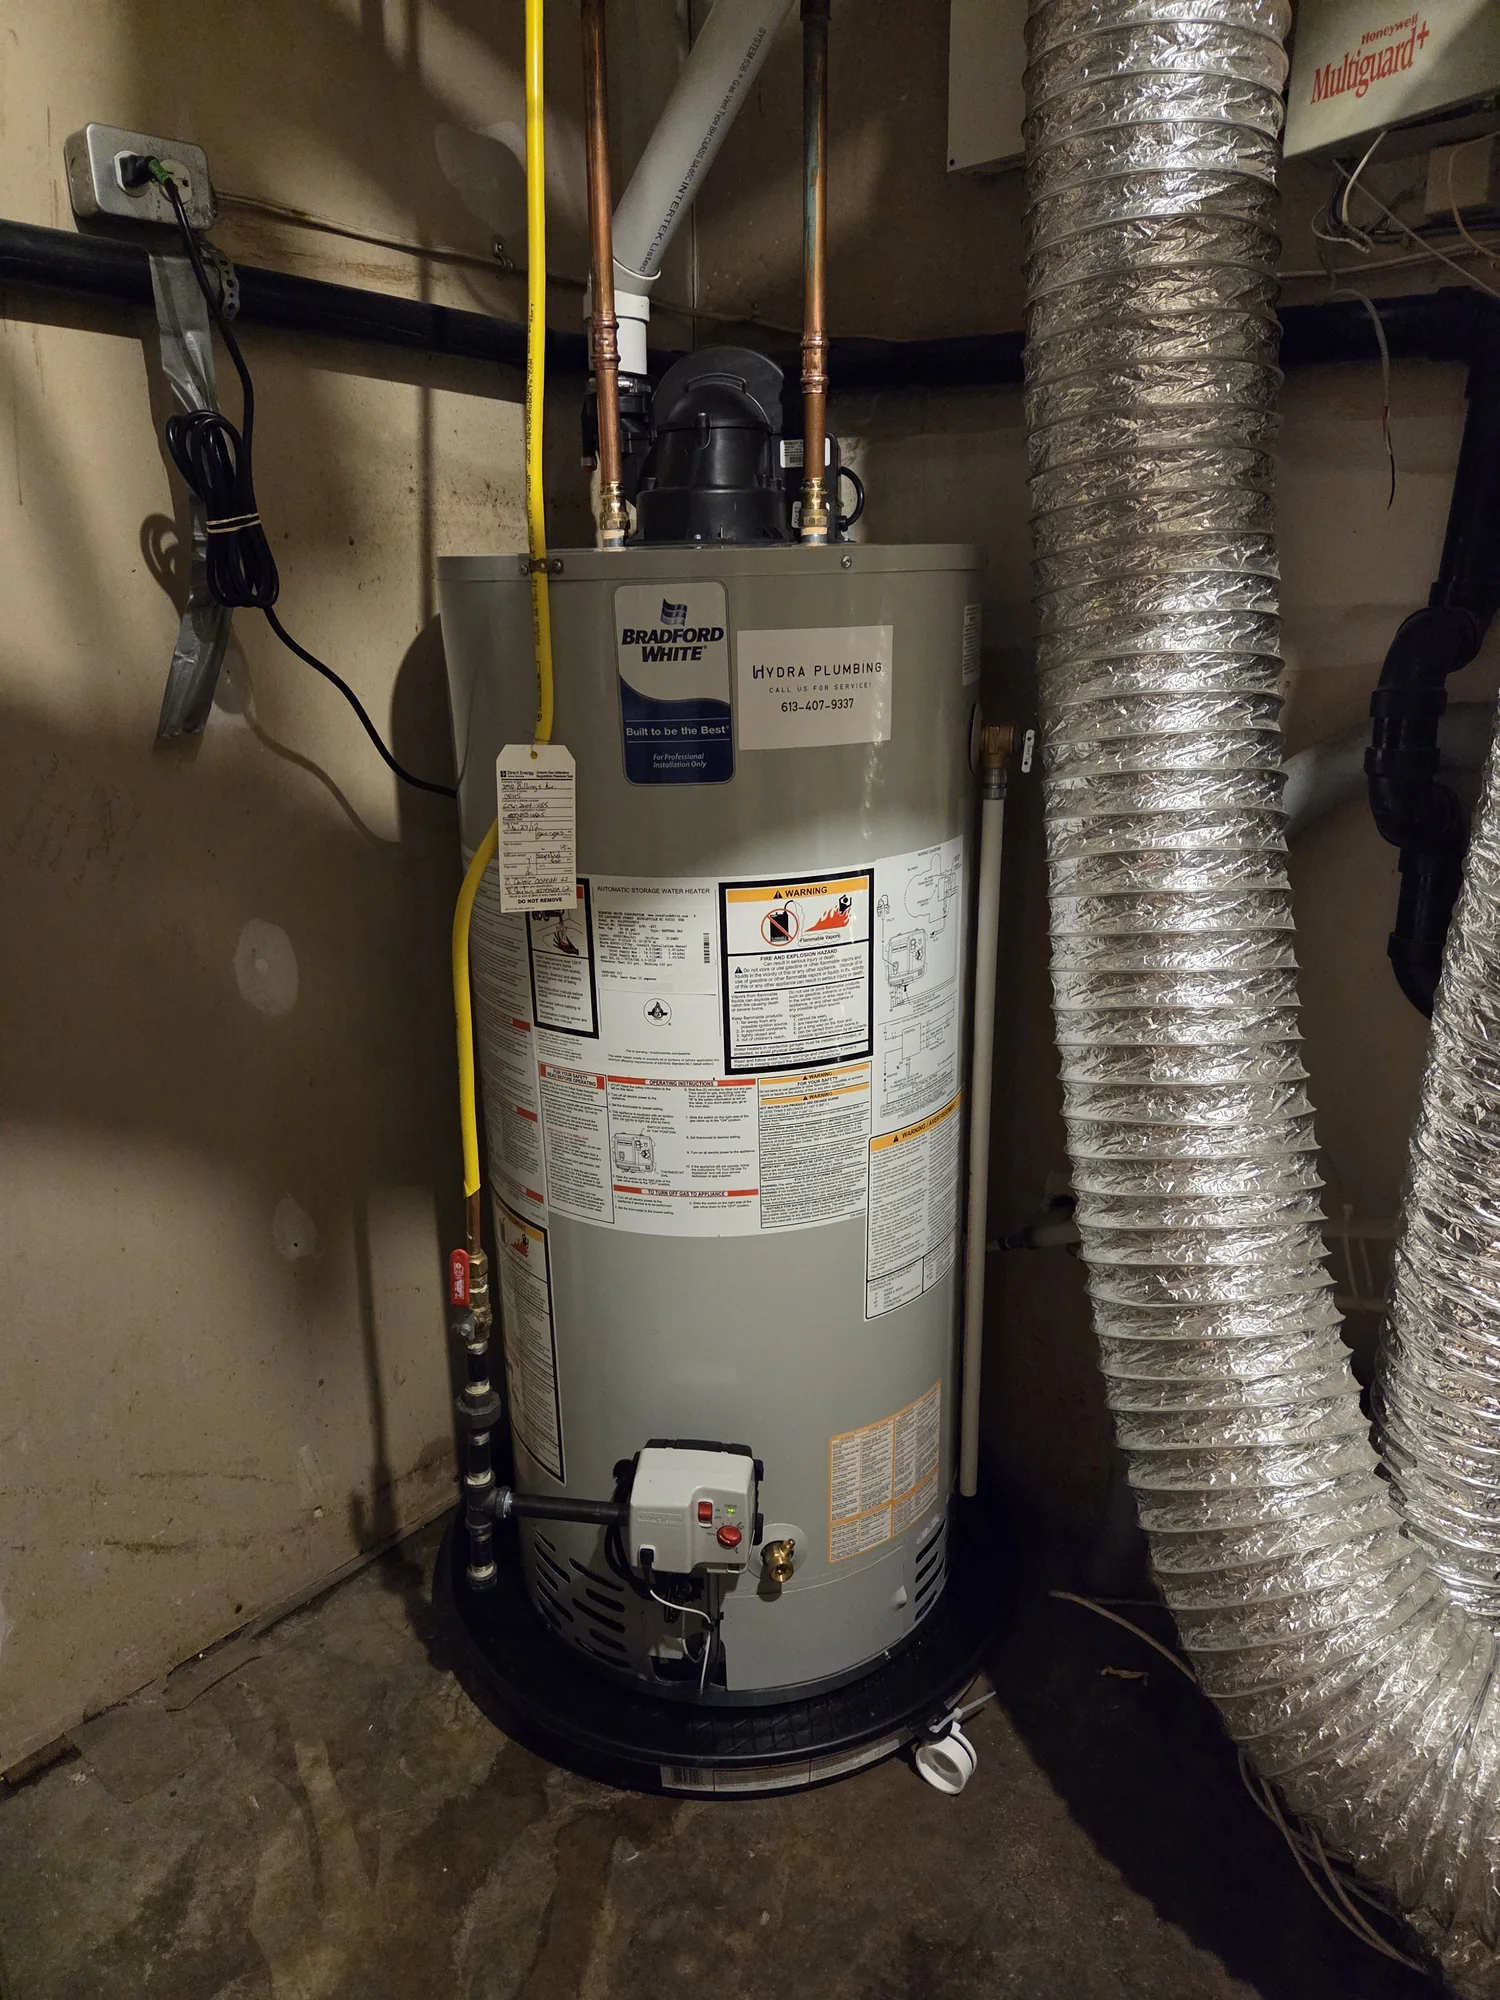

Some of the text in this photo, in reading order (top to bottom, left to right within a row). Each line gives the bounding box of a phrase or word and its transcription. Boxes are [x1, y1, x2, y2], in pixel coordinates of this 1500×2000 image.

[1361, 12, 1419, 46] Honeywell
[746, 27, 766, 61] SYSTEM
[740, 58, 751, 74] 636
[728, 79, 740, 94] Gas
[713, 109, 726, 126] Type
[708, 124, 718, 137] BH
[696, 136, 712, 160] CLASS
[656, 180, 690, 241] INTERTEK
[638, 240, 660, 272] Listed
[622, 627, 724, 645] BRADFORD
[642, 646, 703, 662] WHITE
[752, 662, 882, 680] HYDRA PLUMBING
[781, 698, 854, 712] 613-407-9337
[626, 726, 726, 736] Built to be the Best
[664, 752, 704, 760] Professional
[690, 760, 707, 769] Only
[785, 886, 828, 898] WARNING
[786, 952, 816, 960] EXPLOSION
[809, 1072, 832, 1080] WARNING
